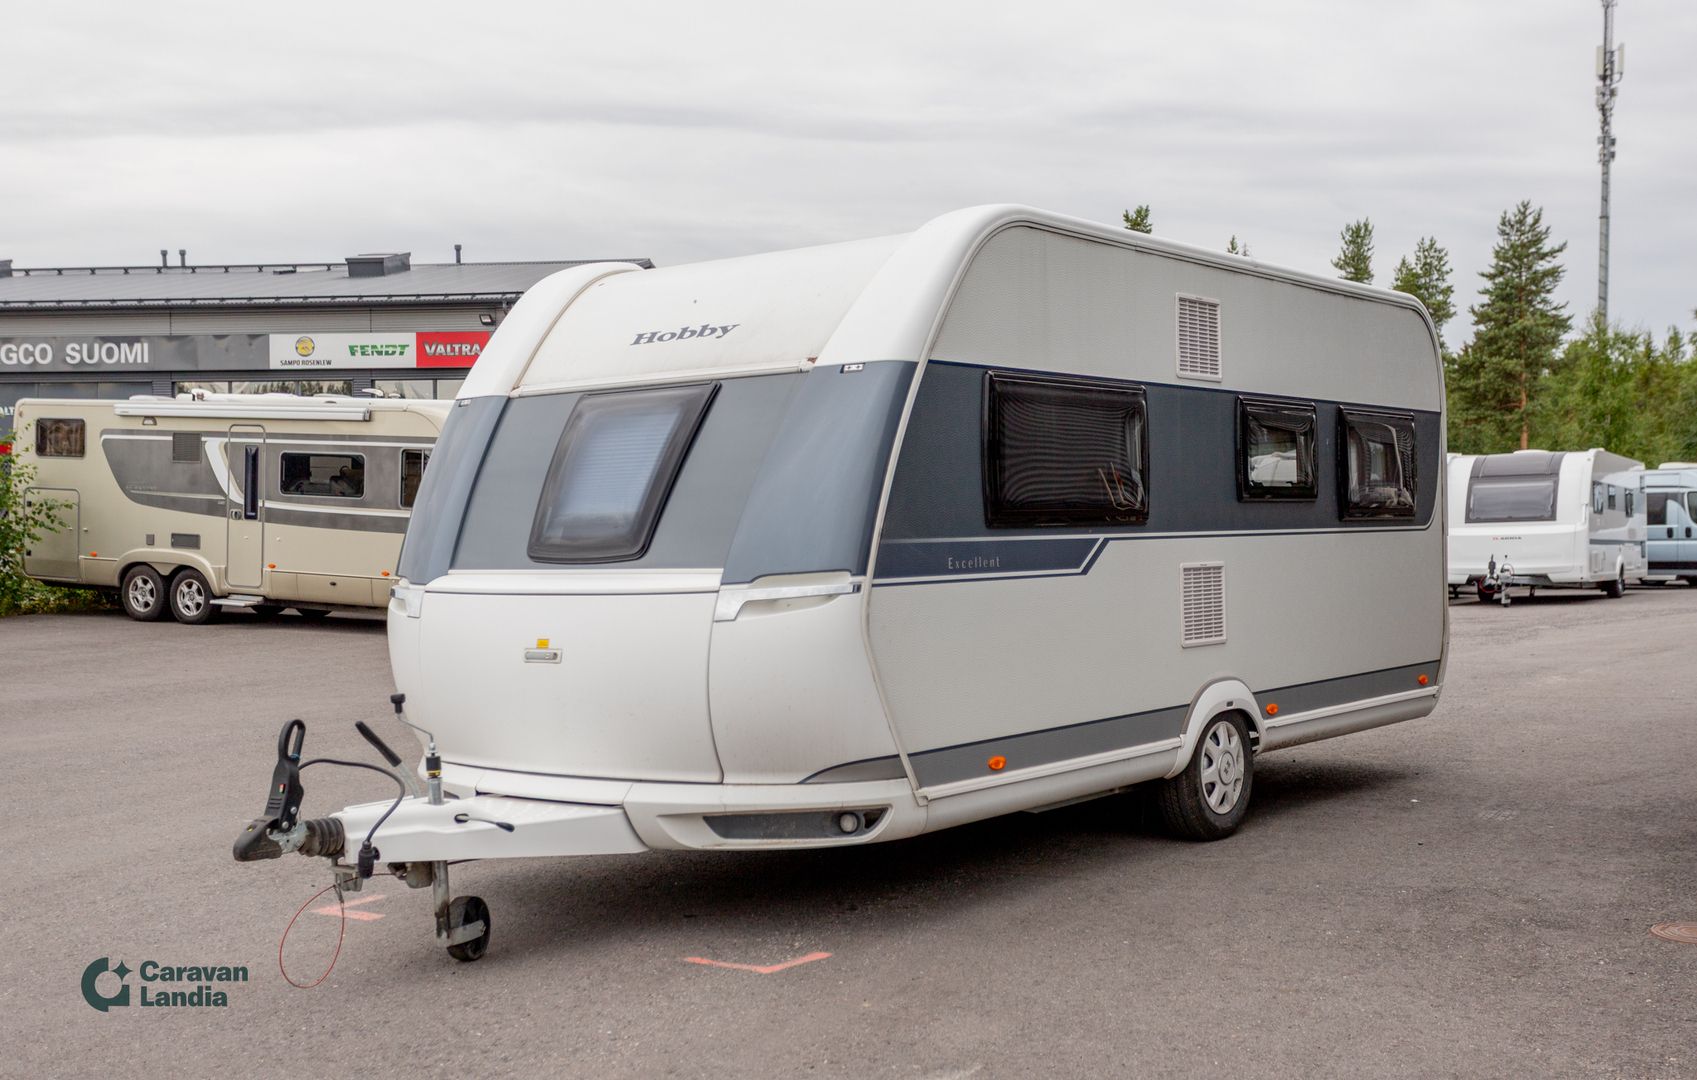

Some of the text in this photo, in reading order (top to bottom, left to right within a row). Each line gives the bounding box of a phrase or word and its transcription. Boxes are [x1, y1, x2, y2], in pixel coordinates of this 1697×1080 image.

[630, 323, 741, 346] Hobby
[65, 342, 149, 364] SUOMI
[348, 344, 410, 357] FENDT
[423, 341, 482, 356] VALTRA
[947, 556, 1001, 570] Excellent
